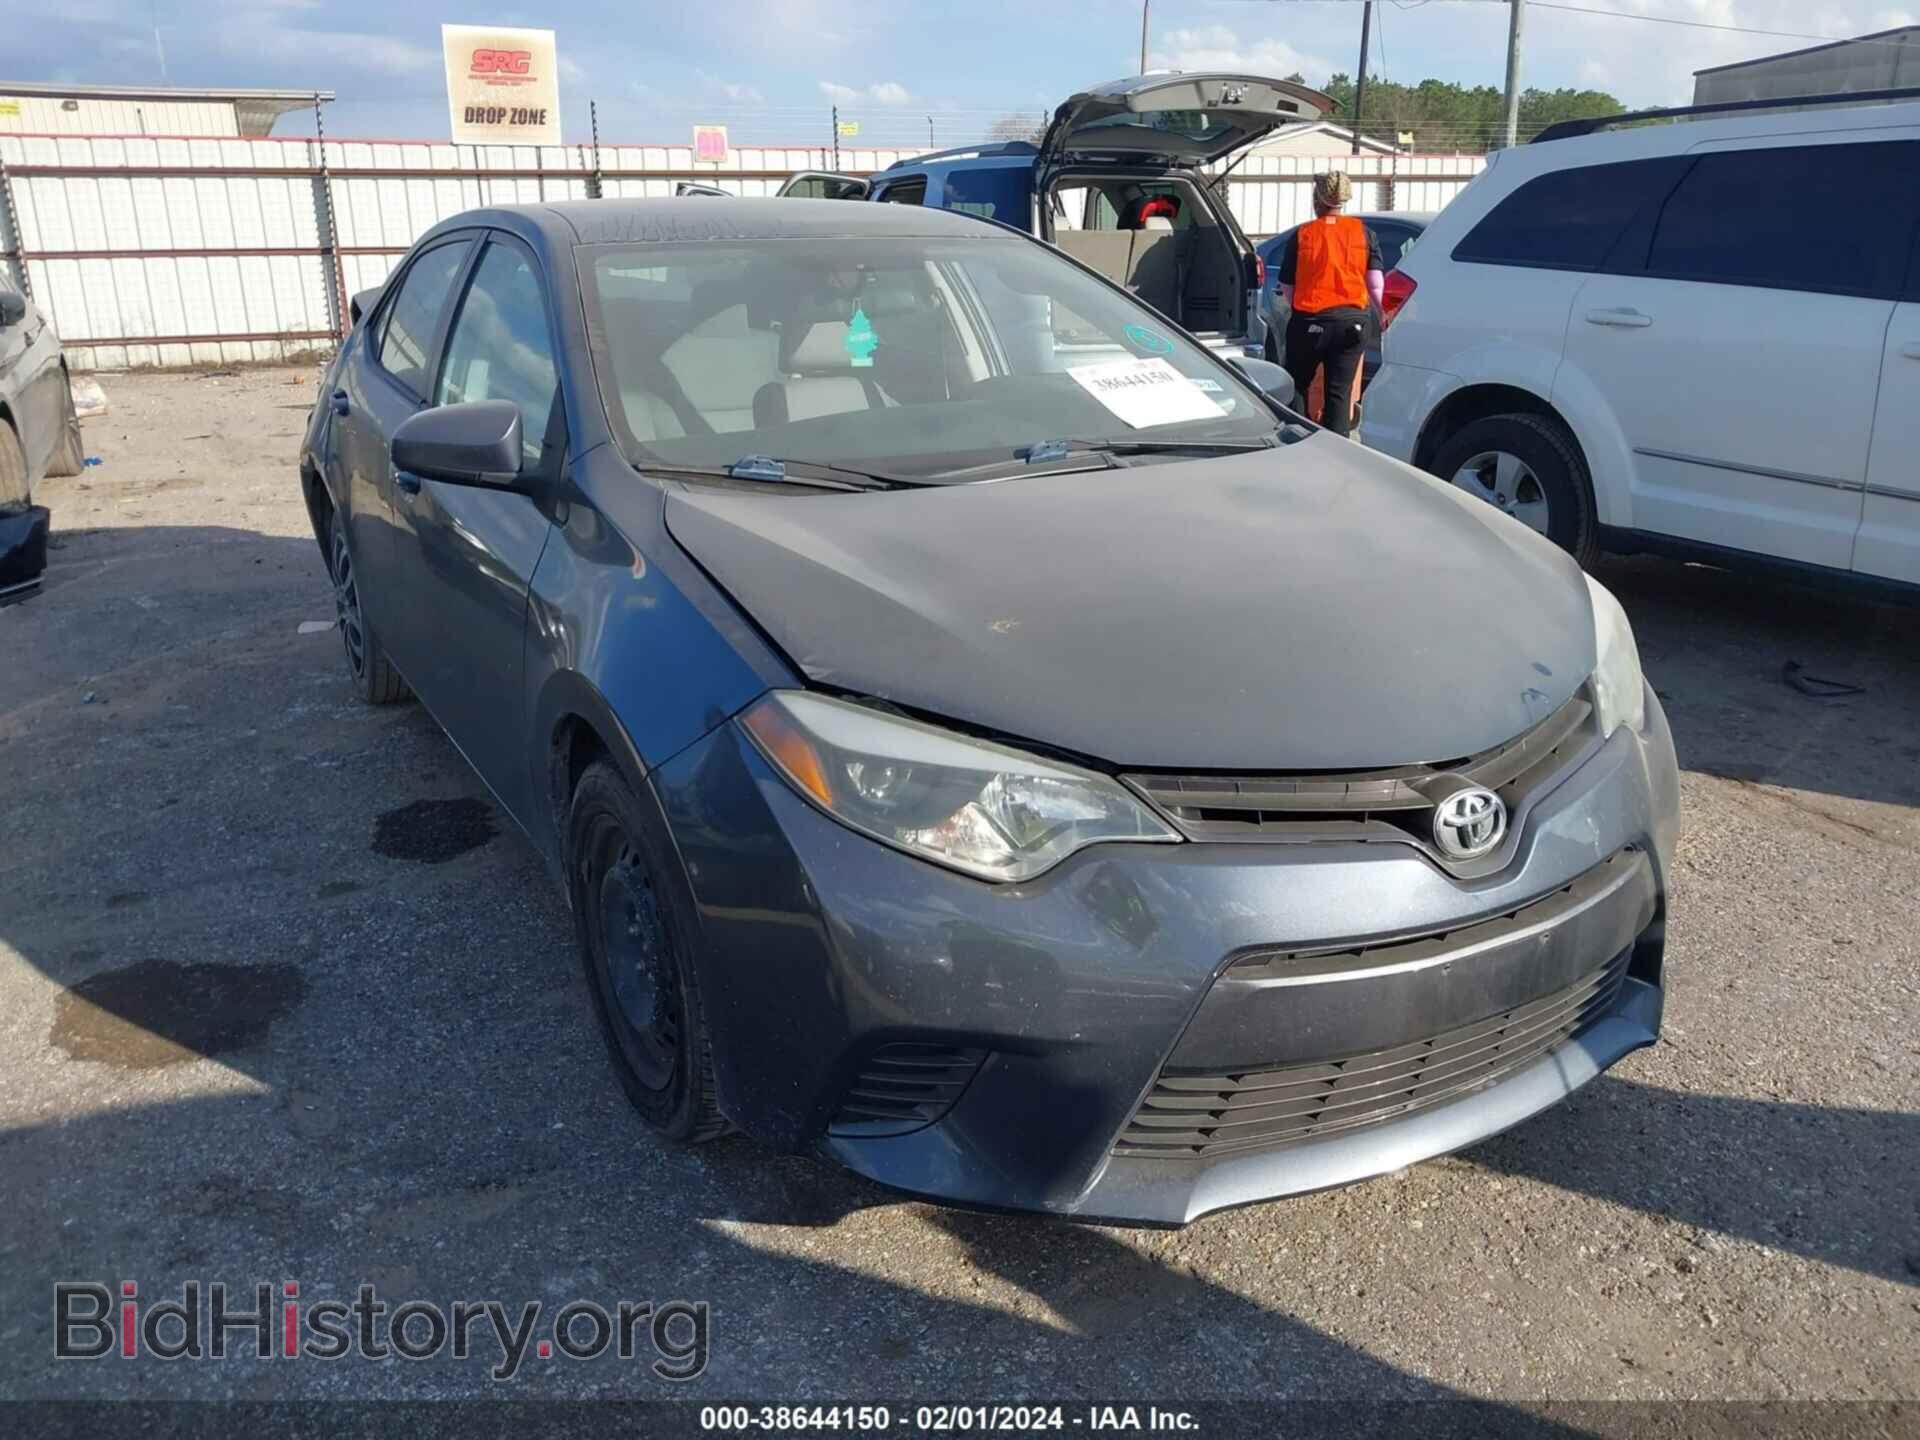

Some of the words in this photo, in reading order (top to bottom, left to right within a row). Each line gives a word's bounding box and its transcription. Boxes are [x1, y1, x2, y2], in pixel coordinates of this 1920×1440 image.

[470, 48, 531, 74] SRG
[464, 106, 507, 124] DROP
[509, 107, 547, 125] ZONE
